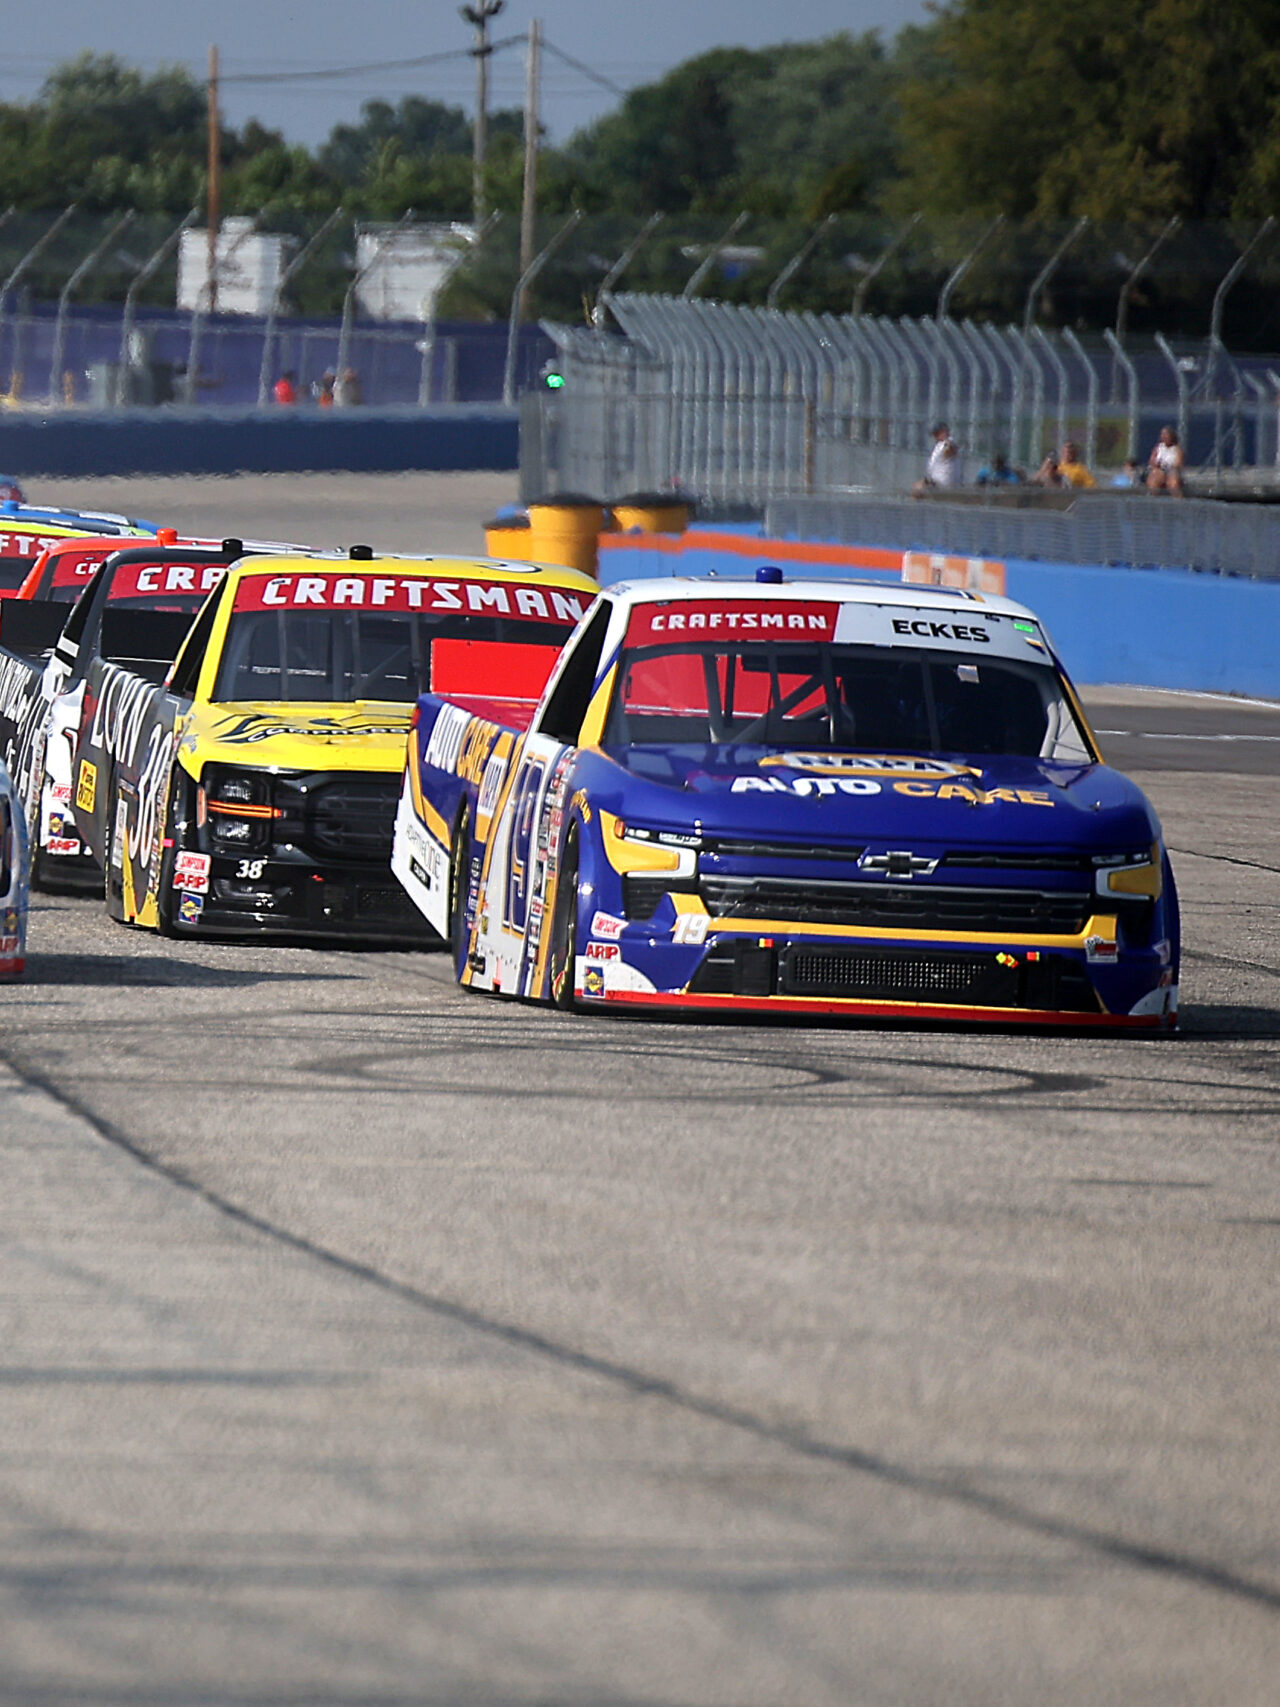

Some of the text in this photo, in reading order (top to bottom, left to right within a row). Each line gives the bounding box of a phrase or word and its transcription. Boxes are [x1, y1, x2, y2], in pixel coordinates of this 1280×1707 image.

[261, 577, 584, 621] CRAFTSMAN
[650, 613, 991, 643] CRAFTSMAN ECKES
[731, 776, 1055, 807] AUTO CARE
[235, 858, 267, 880] 38
[673, 914, 712, 944] 19
[586, 945, 619, 960] ARP
